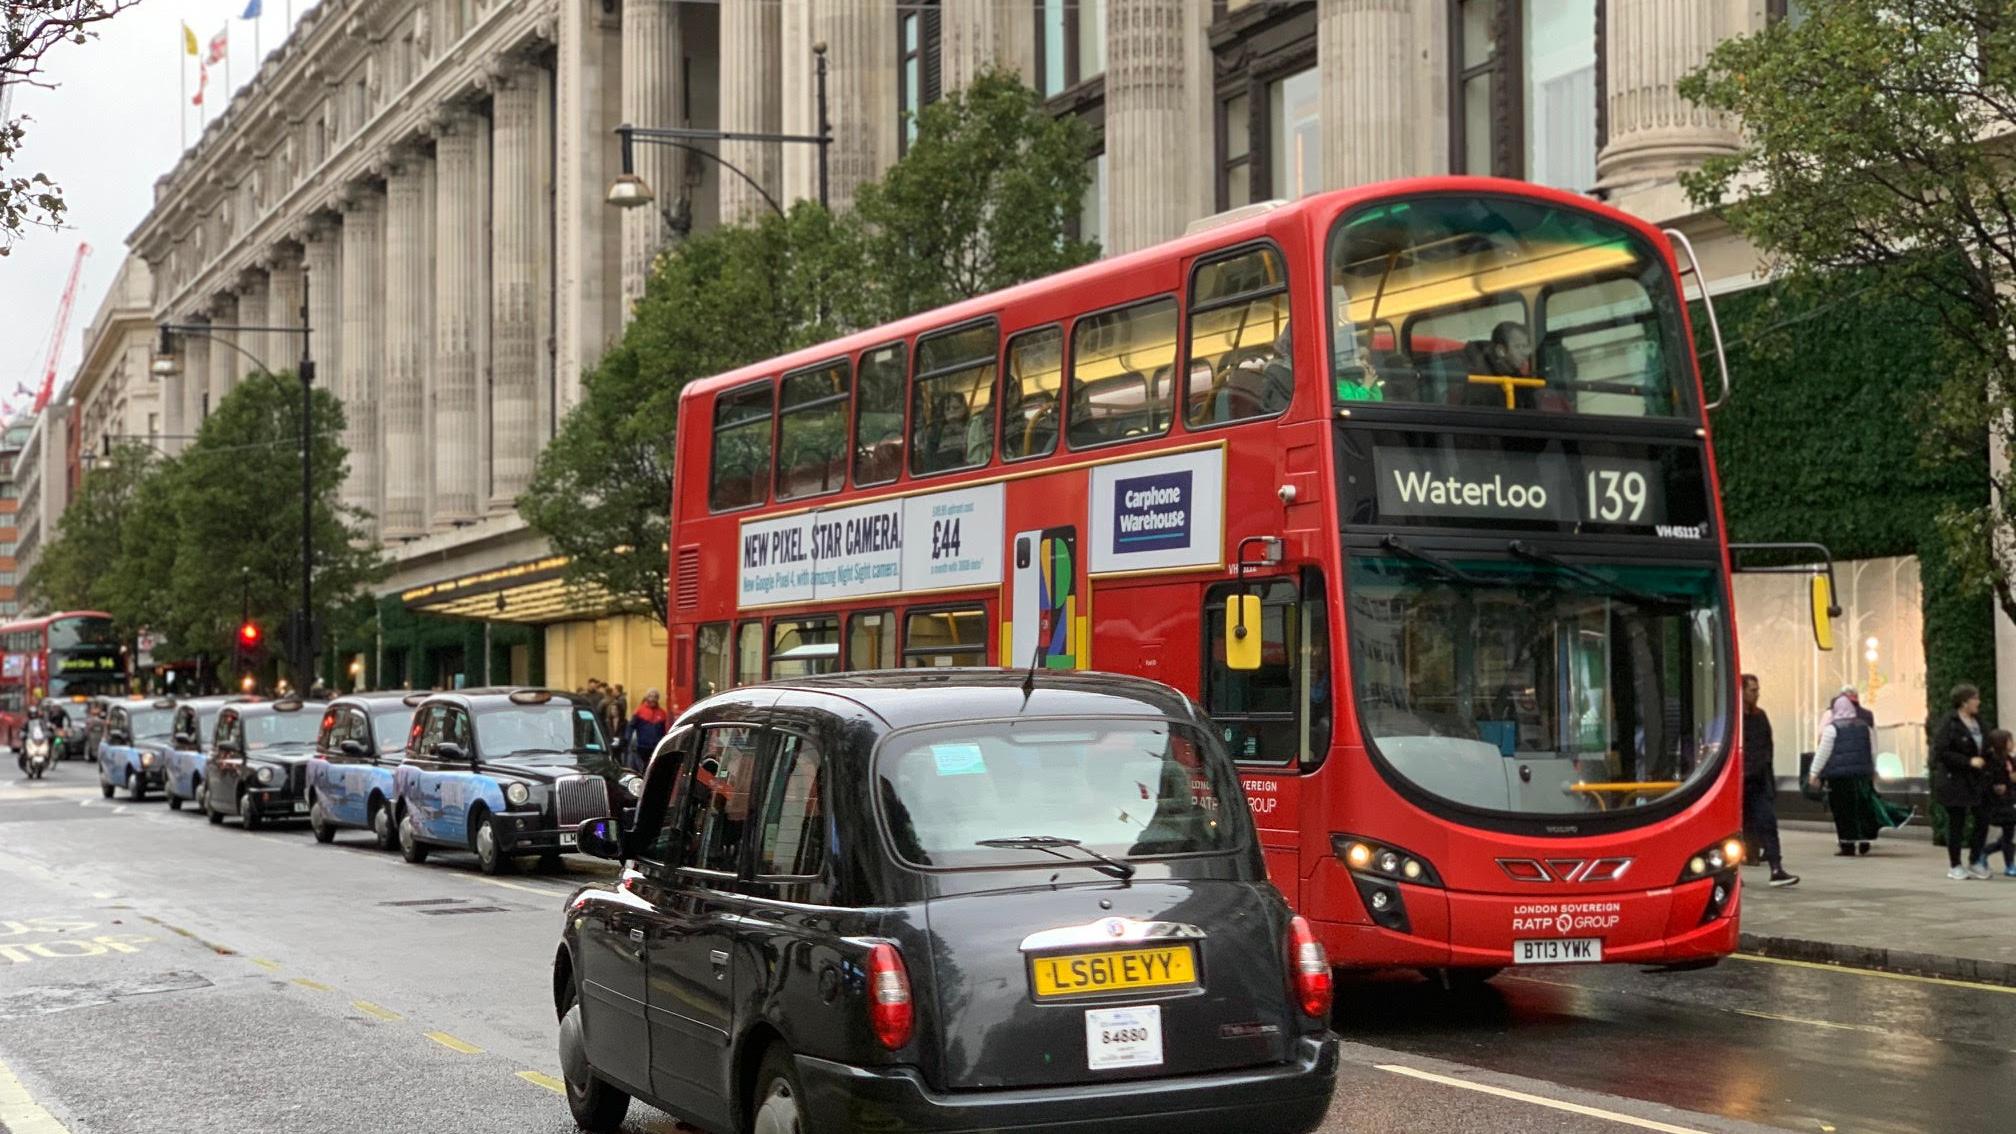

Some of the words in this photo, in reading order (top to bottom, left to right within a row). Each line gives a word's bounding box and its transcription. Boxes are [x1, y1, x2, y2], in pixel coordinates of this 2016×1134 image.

[1125, 486, 1181, 510] Carphone
[1393, 470, 1547, 509] Waterloo
[1588, 470, 1647, 522] 139
[1120, 510, 1185, 533] Warehouse
[743, 532, 770, 569] NEW
[772, 527, 807, 565] PIXEL.
[811, 522, 842, 560] STAR
[846, 512, 902, 557] CAMERA.
[932, 517, 960, 560] £44
[755, 571, 775, 594] Google
[775, 571, 790, 589] Pixel
[1241, 781, 1278, 792] VEREIGN
[1247, 796, 1277, 813] ROUP
[1514, 905, 1558, 914] LONDON
[1560, 903, 1620, 913] SOVEREIGN
[1512, 917, 1553, 930] RATP
[1574, 915, 1620, 928] GROUP
[0, 934, 160, 962] TOP
[1524, 942, 1558, 959] BT13
[1562, 940, 1591, 958] YWK
[1052, 957, 1116, 989] LS61
[1123, 953, 1172, 982] EYY
[1102, 1027, 1148, 1044] 84880
